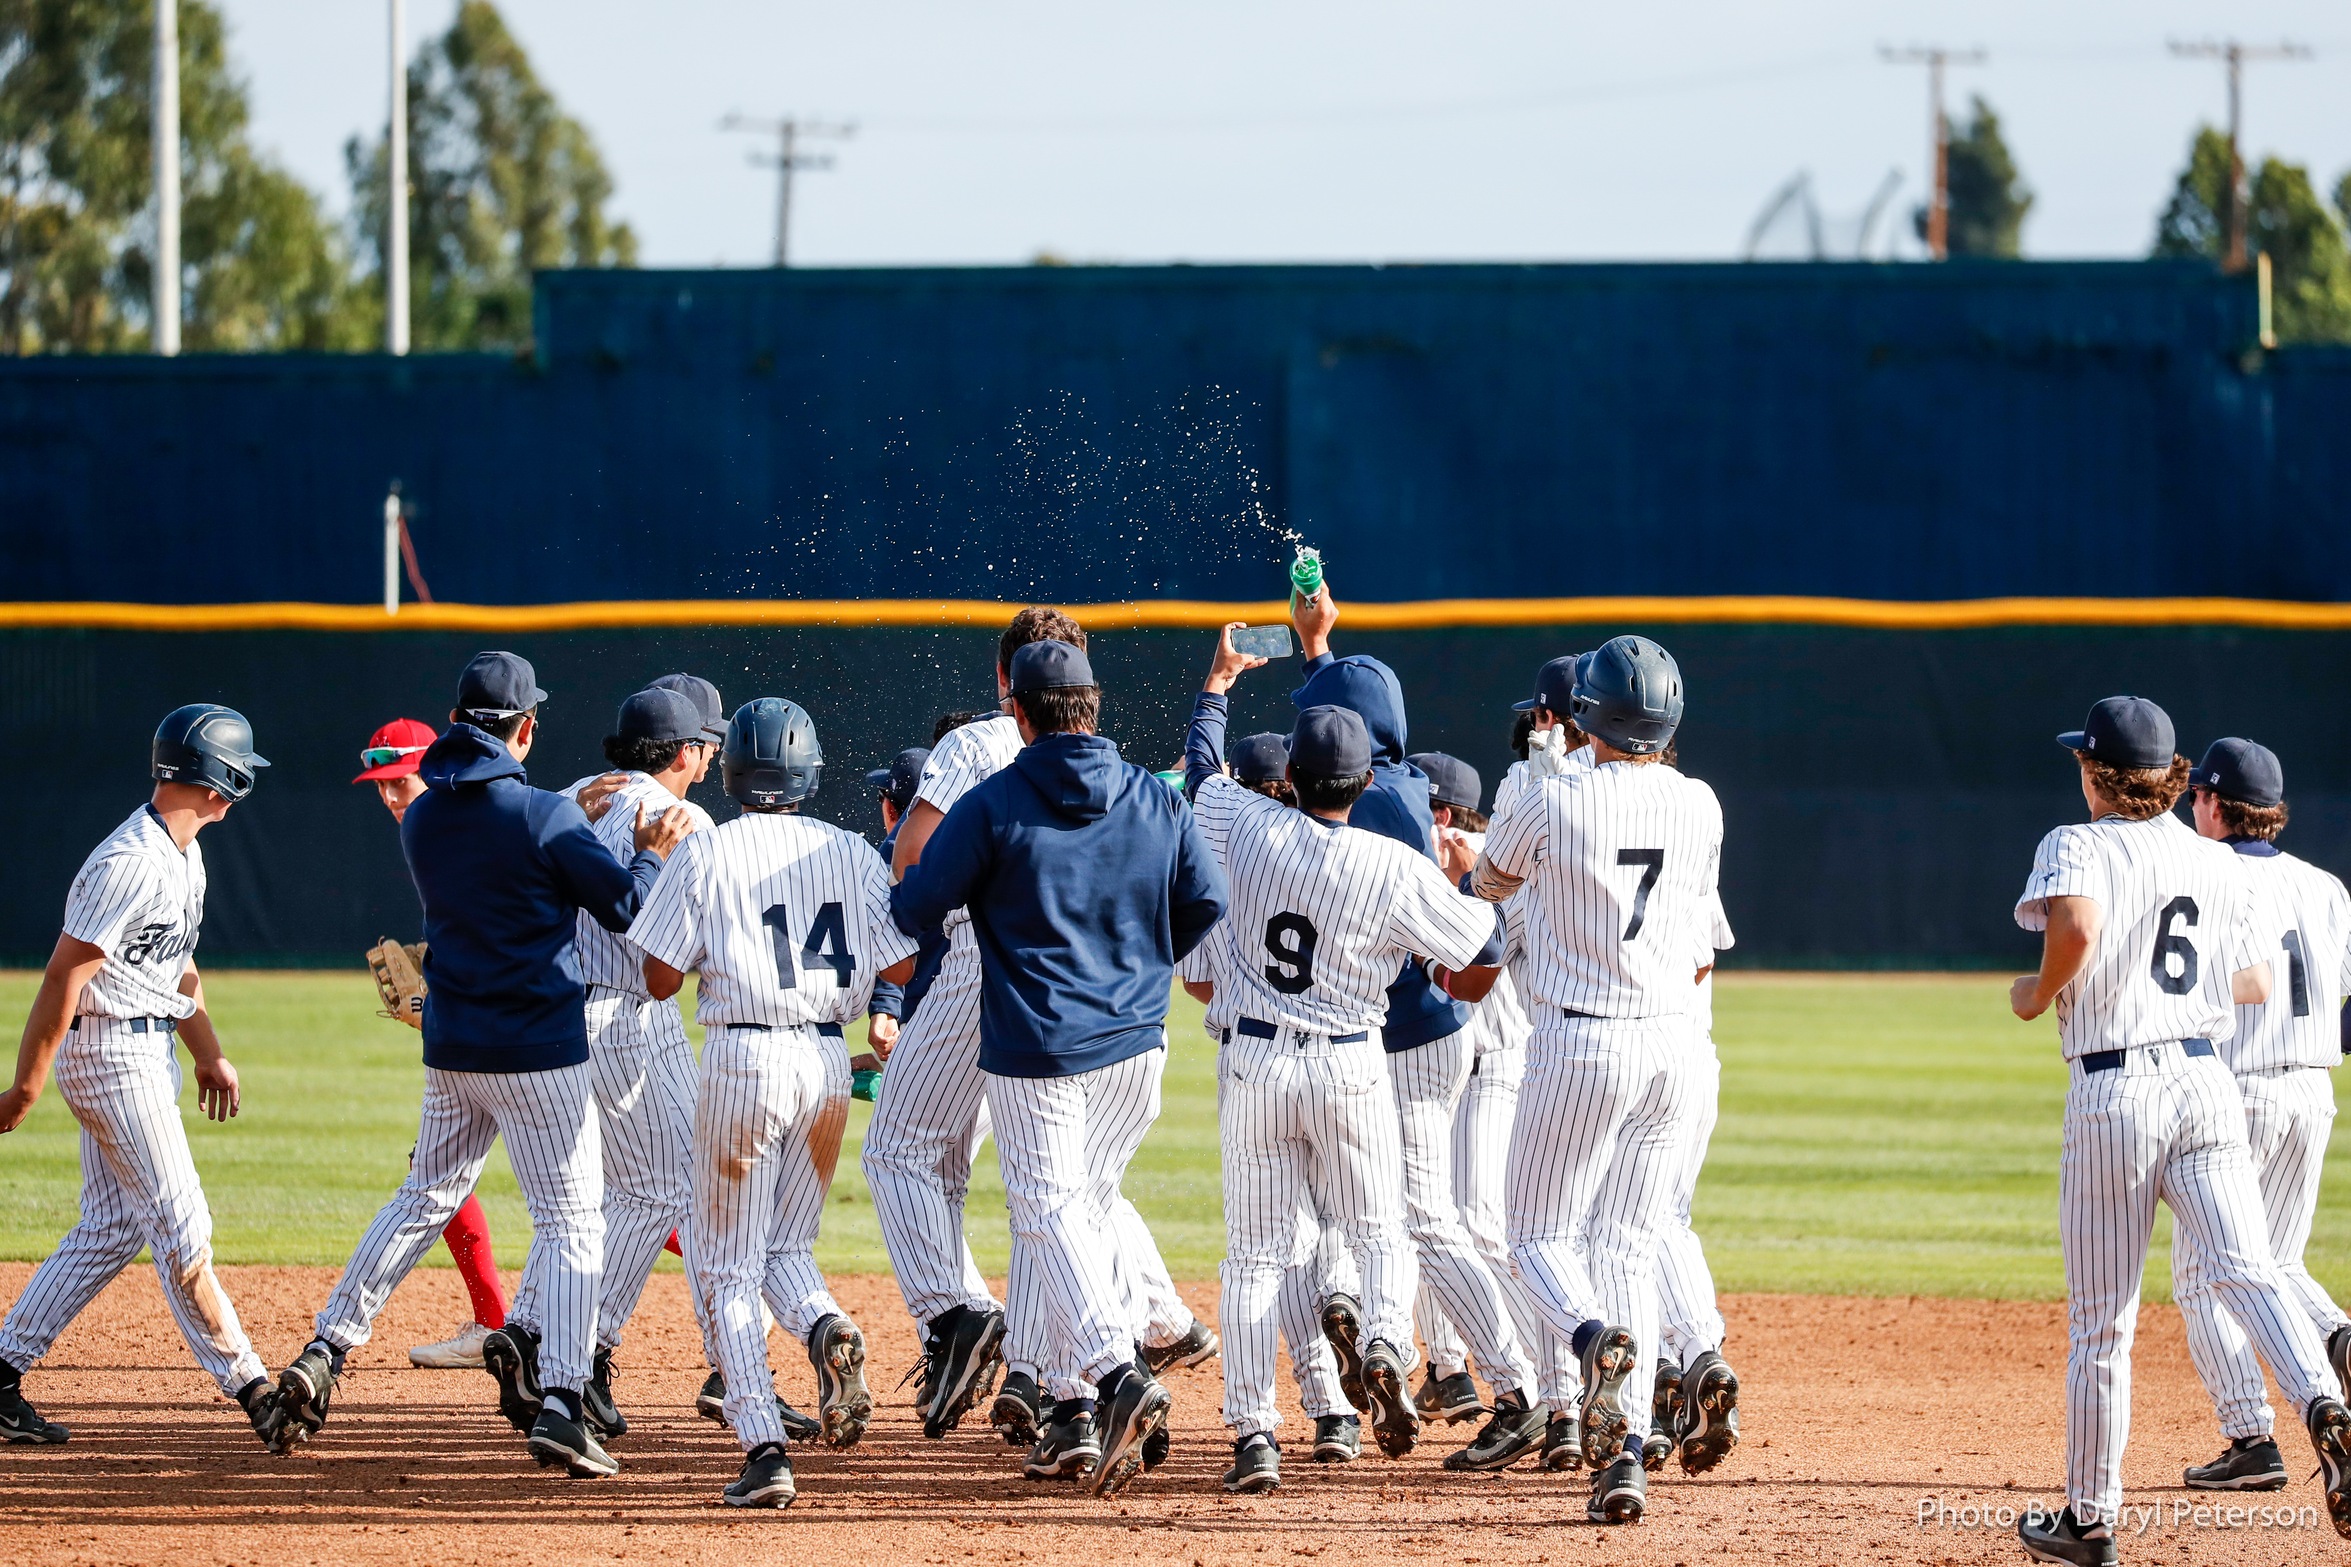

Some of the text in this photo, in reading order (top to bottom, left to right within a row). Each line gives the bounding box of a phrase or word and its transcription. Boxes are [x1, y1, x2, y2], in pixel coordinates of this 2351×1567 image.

[124, 909, 194, 965] Fal
[1616, 848, 1664, 941] 7
[762, 901, 856, 990] 14
[1264, 911, 1318, 994] 9
[2150, 895, 2199, 995] 6
[2280, 929, 2309, 1017] 1
